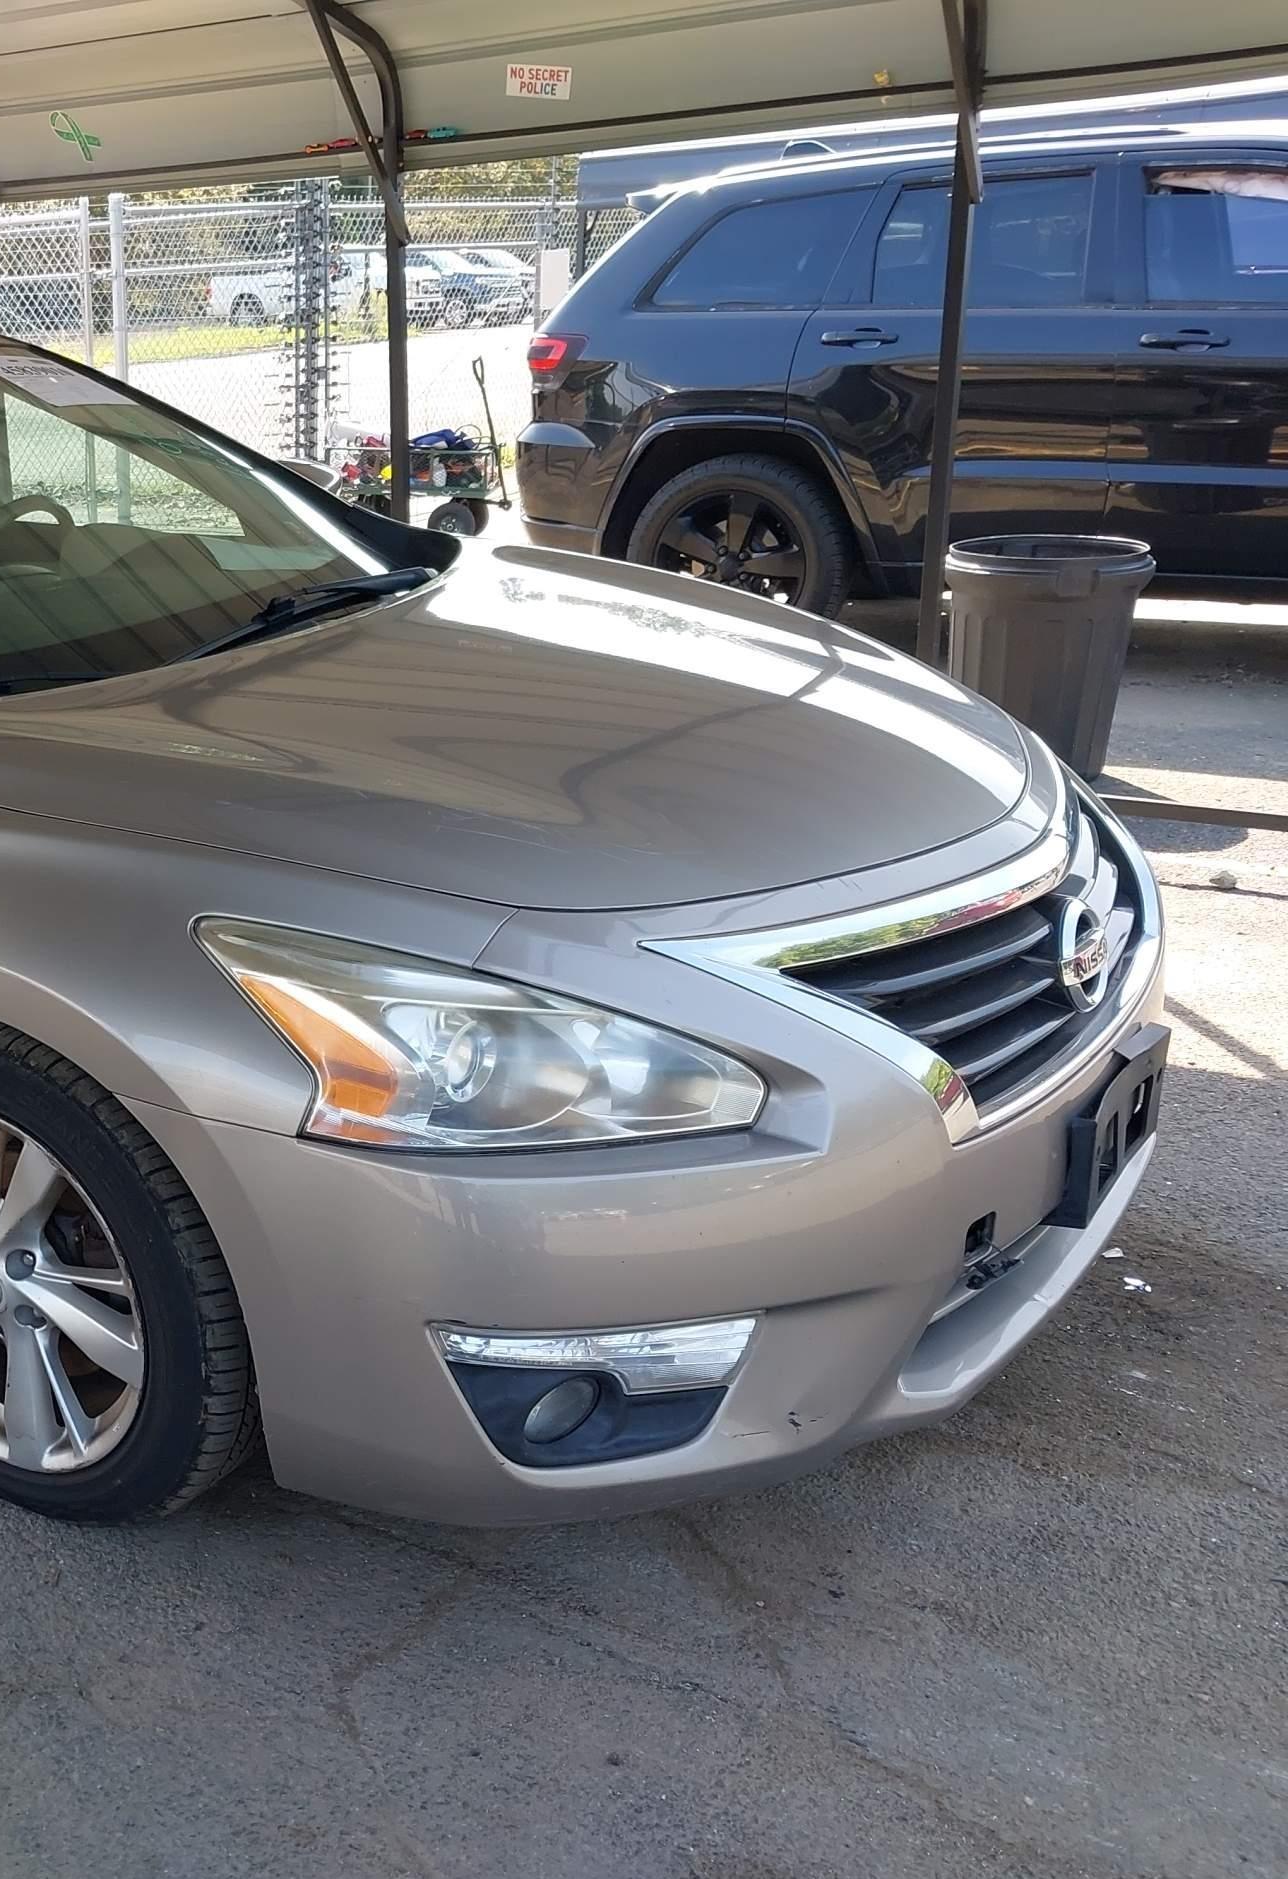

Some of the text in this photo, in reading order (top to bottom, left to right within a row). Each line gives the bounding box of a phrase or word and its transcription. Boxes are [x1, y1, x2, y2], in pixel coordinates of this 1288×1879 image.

[510, 67, 569, 82] NO SECRET
[520, 81, 558, 96] POLICE
